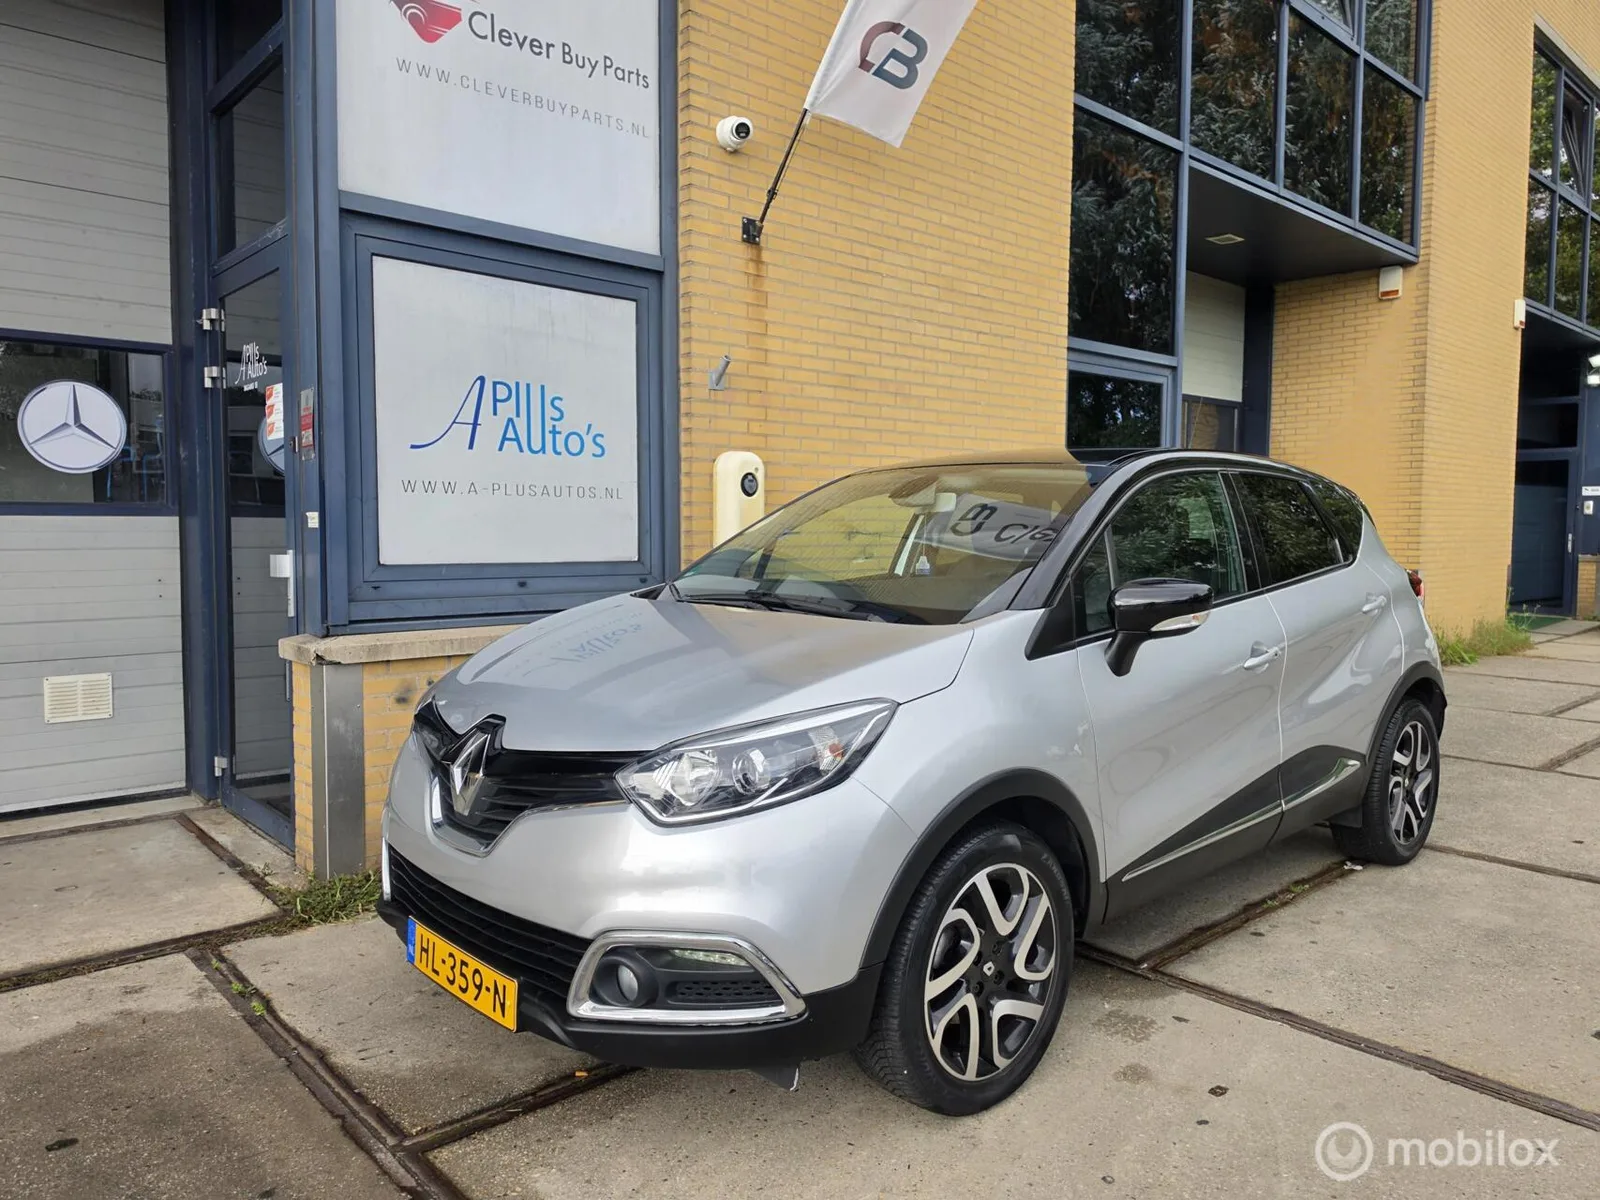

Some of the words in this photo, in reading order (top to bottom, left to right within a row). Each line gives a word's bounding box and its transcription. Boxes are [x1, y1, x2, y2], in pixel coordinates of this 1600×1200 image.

[468, 11, 555, 59] Clever
[562, 42, 599, 78] Buy
[603, 55, 650, 89] Parts
[396, 57, 650, 139] WWW.CLEVERBUYPARTS.NL
[401, 479, 624, 500] WWW.A-PLUSAUTOS.NL
[419, 933, 507, 1019] HL-359-N
